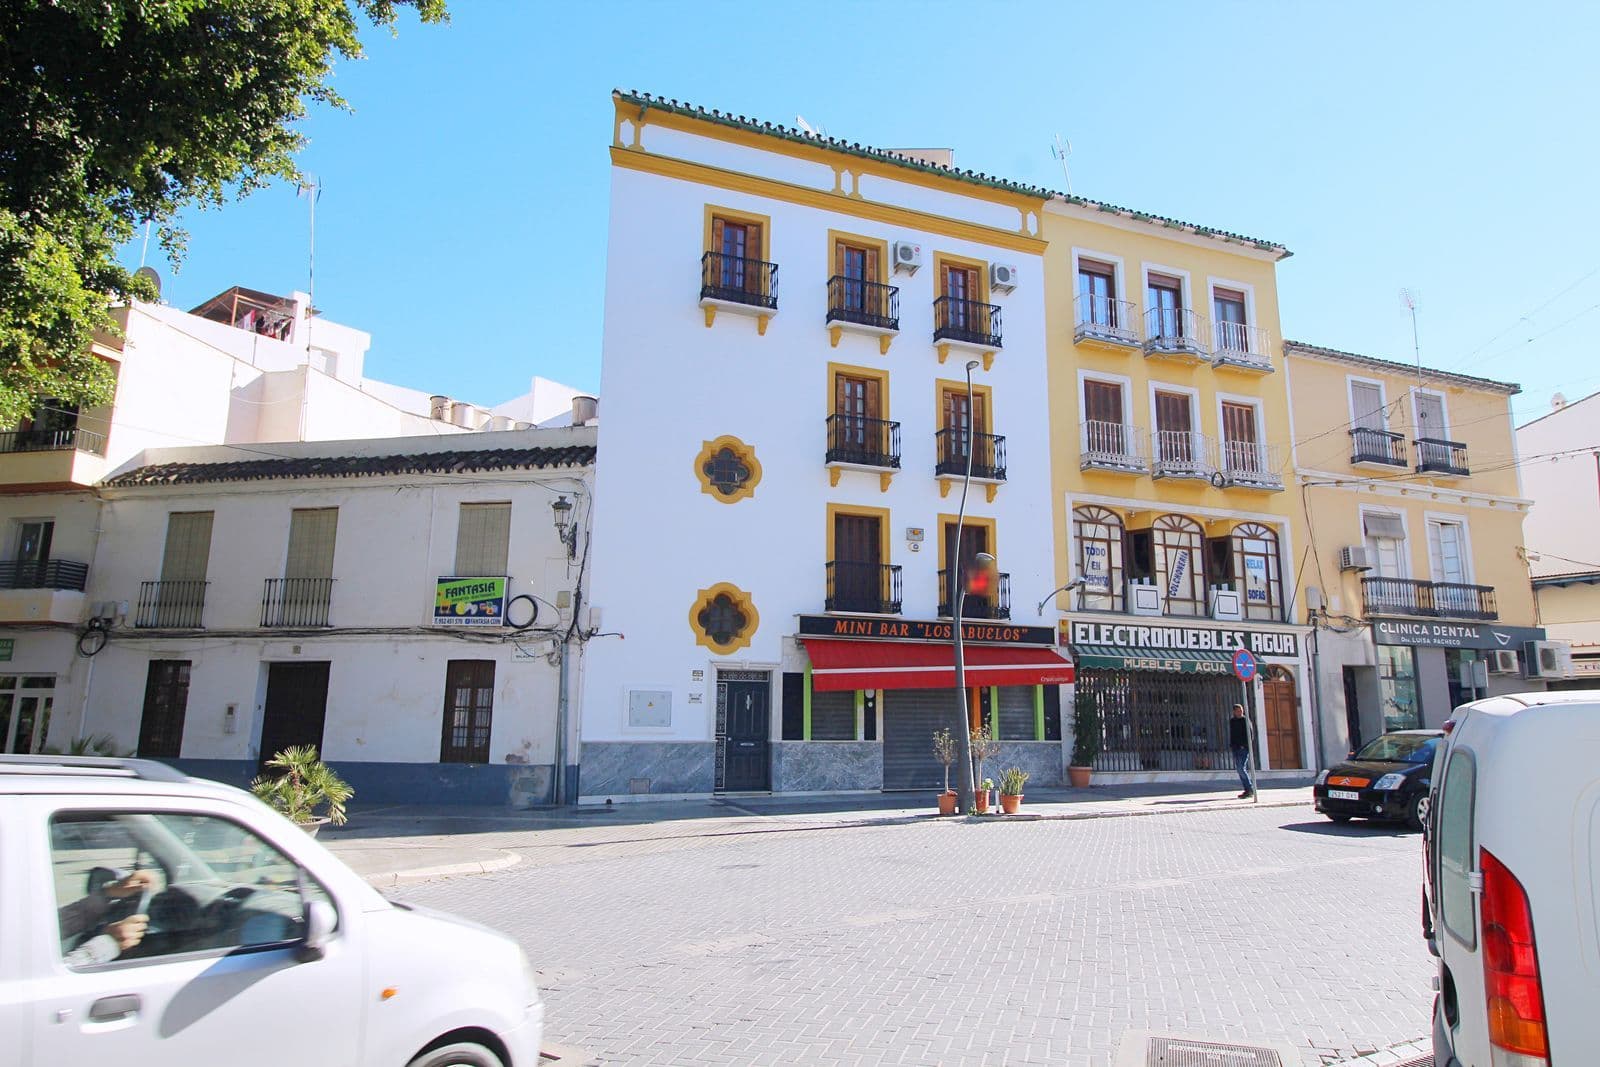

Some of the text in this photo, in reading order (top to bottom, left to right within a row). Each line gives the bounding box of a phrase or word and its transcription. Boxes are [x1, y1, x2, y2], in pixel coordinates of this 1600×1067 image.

[1085, 546, 1106, 557] TODO
[1253, 575, 1258, 585] Y
[445, 582, 495, 598] FANTASIA
[834, 620, 873, 635] MINI
[880, 622, 909, 636] BAR
[917, 623, 952, 638] "LOS
[1379, 622, 1480, 638] CLINICA DENTAL
[1075, 623, 1295, 653] ELECTROMUEBLES AGUA
[1123, 658, 1227, 672] MUEBLES AGUA
